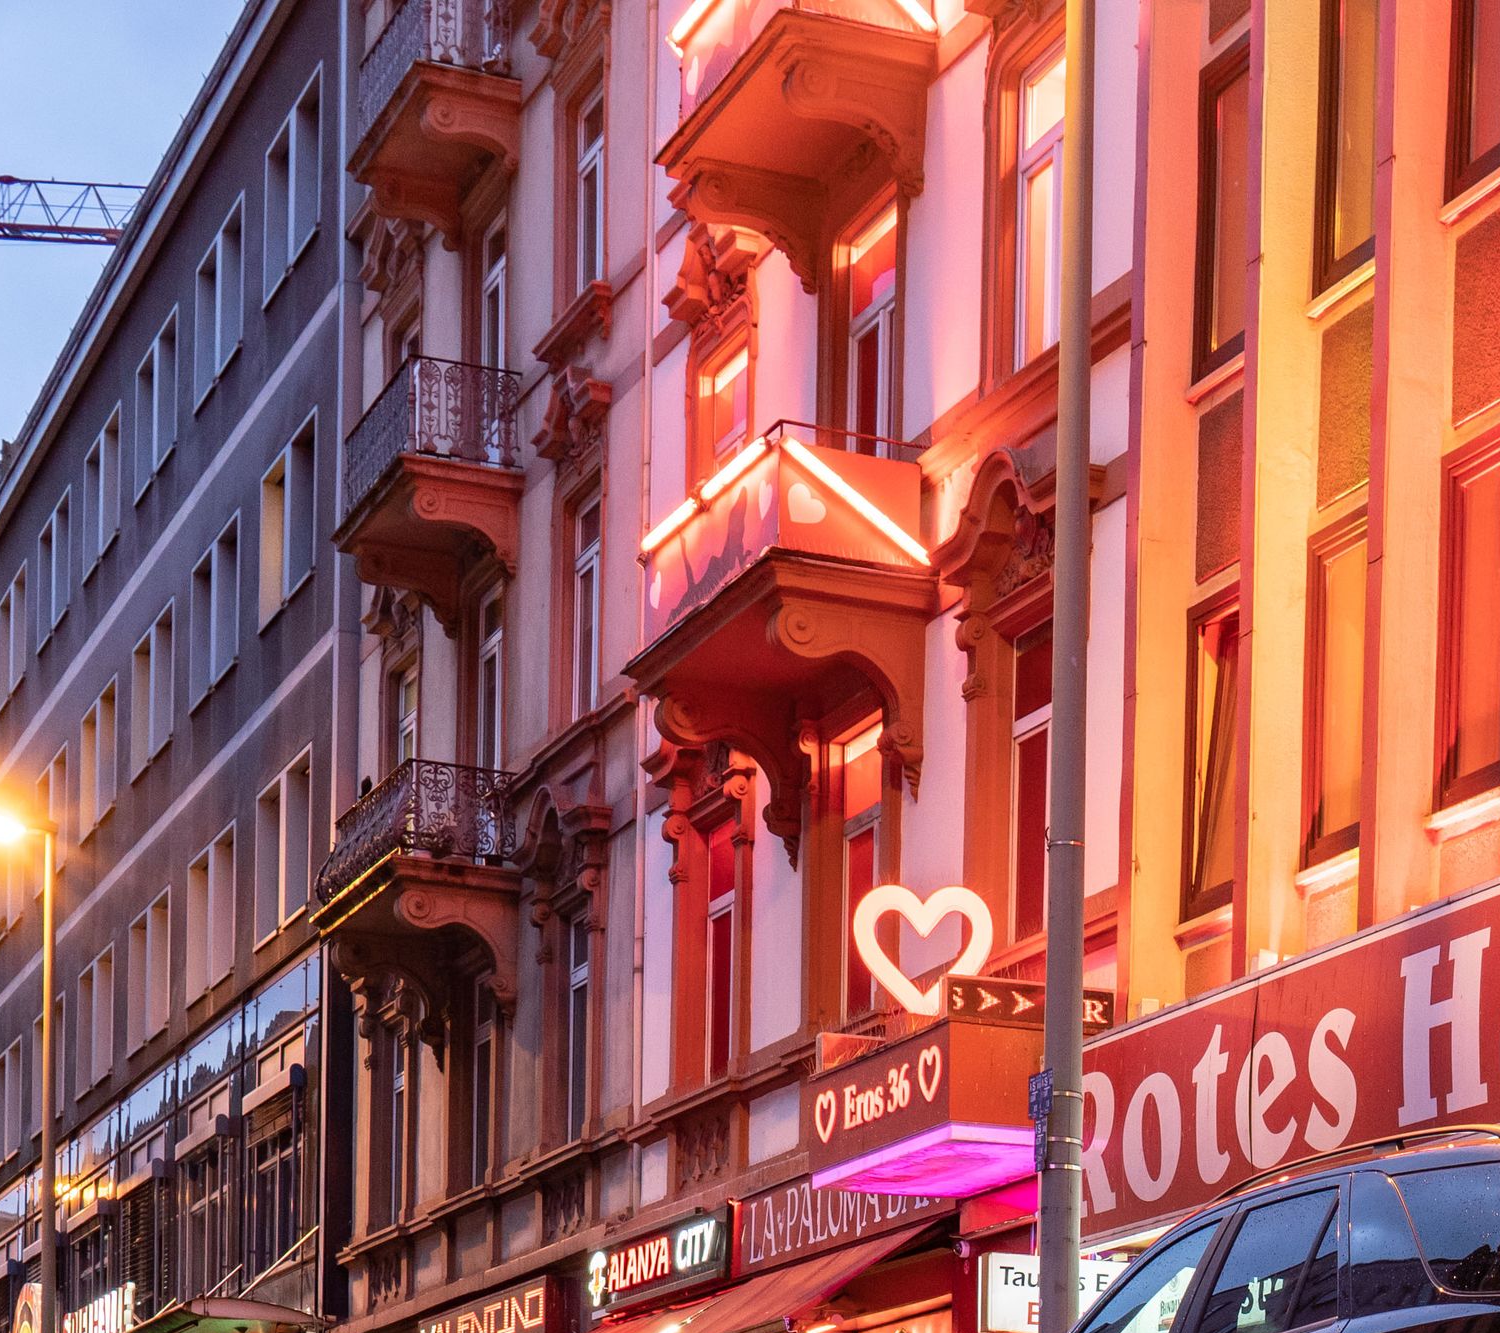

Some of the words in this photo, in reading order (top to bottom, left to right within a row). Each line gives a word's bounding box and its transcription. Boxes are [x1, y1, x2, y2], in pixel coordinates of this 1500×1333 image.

[843, 1084, 885, 1131] Eros
[887, 1062, 912, 1114] 36
[1081, 1007, 1358, 1218] Rotes
[607, 1236, 670, 1294] ALANYA
[675, 1219, 716, 1272] CITY
[1000, 1265, 1087, 1292] Taus
